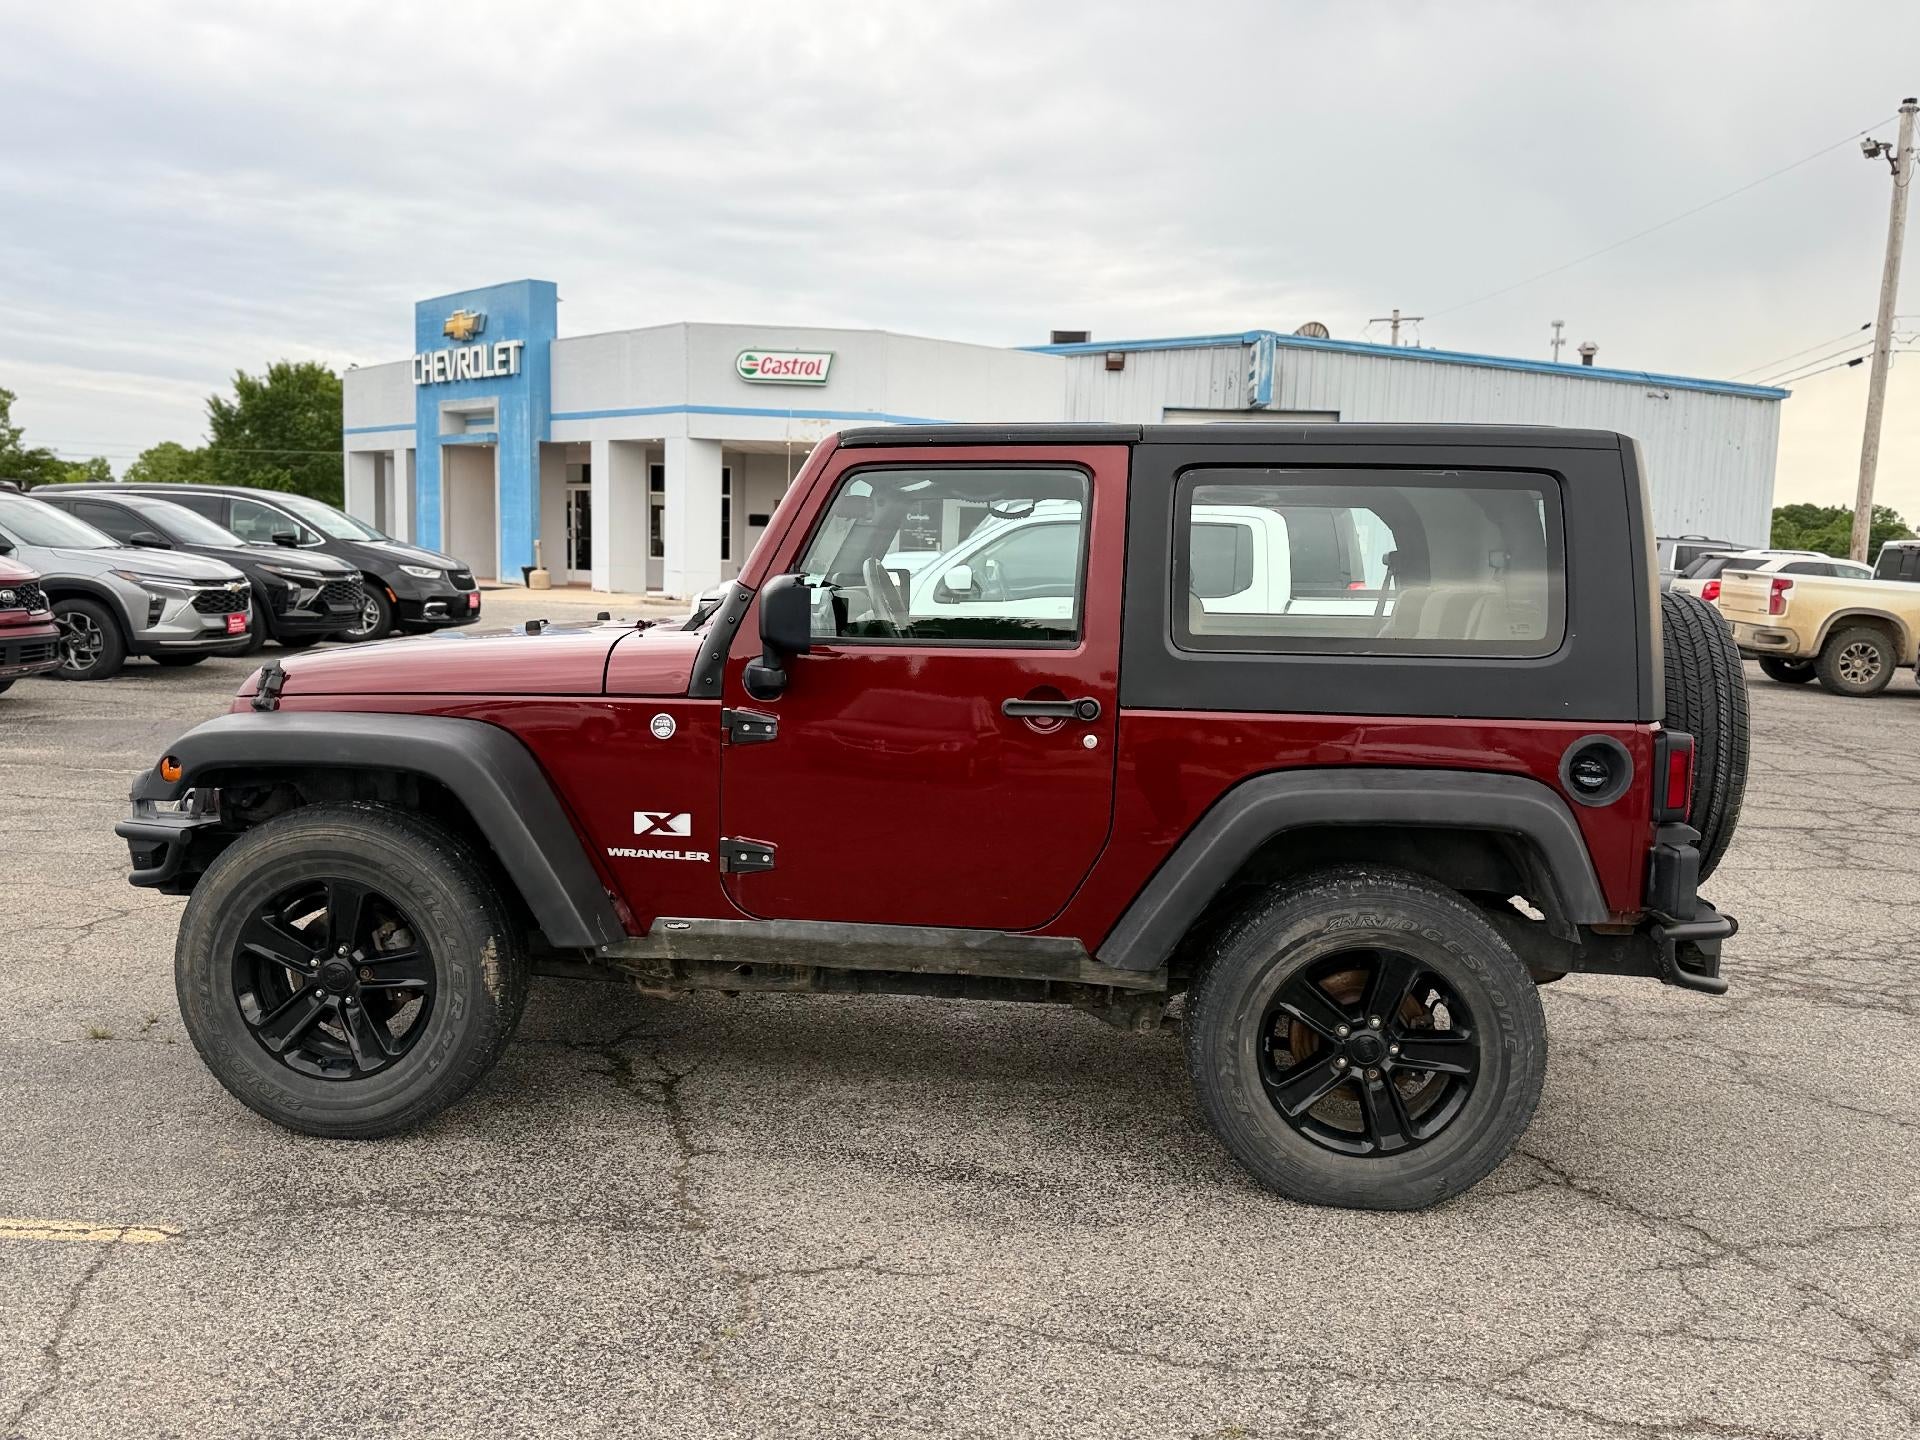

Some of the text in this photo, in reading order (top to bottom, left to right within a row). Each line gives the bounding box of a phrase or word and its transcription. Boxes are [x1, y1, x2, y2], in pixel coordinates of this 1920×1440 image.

[412, 339, 524, 385] CHEVROLET
[760, 357, 822, 375] Castrol
[640, 812, 683, 834] X
[608, 847, 709, 863] WRANGLER
[1322, 911, 1518, 1053] BRIDGESTONE
